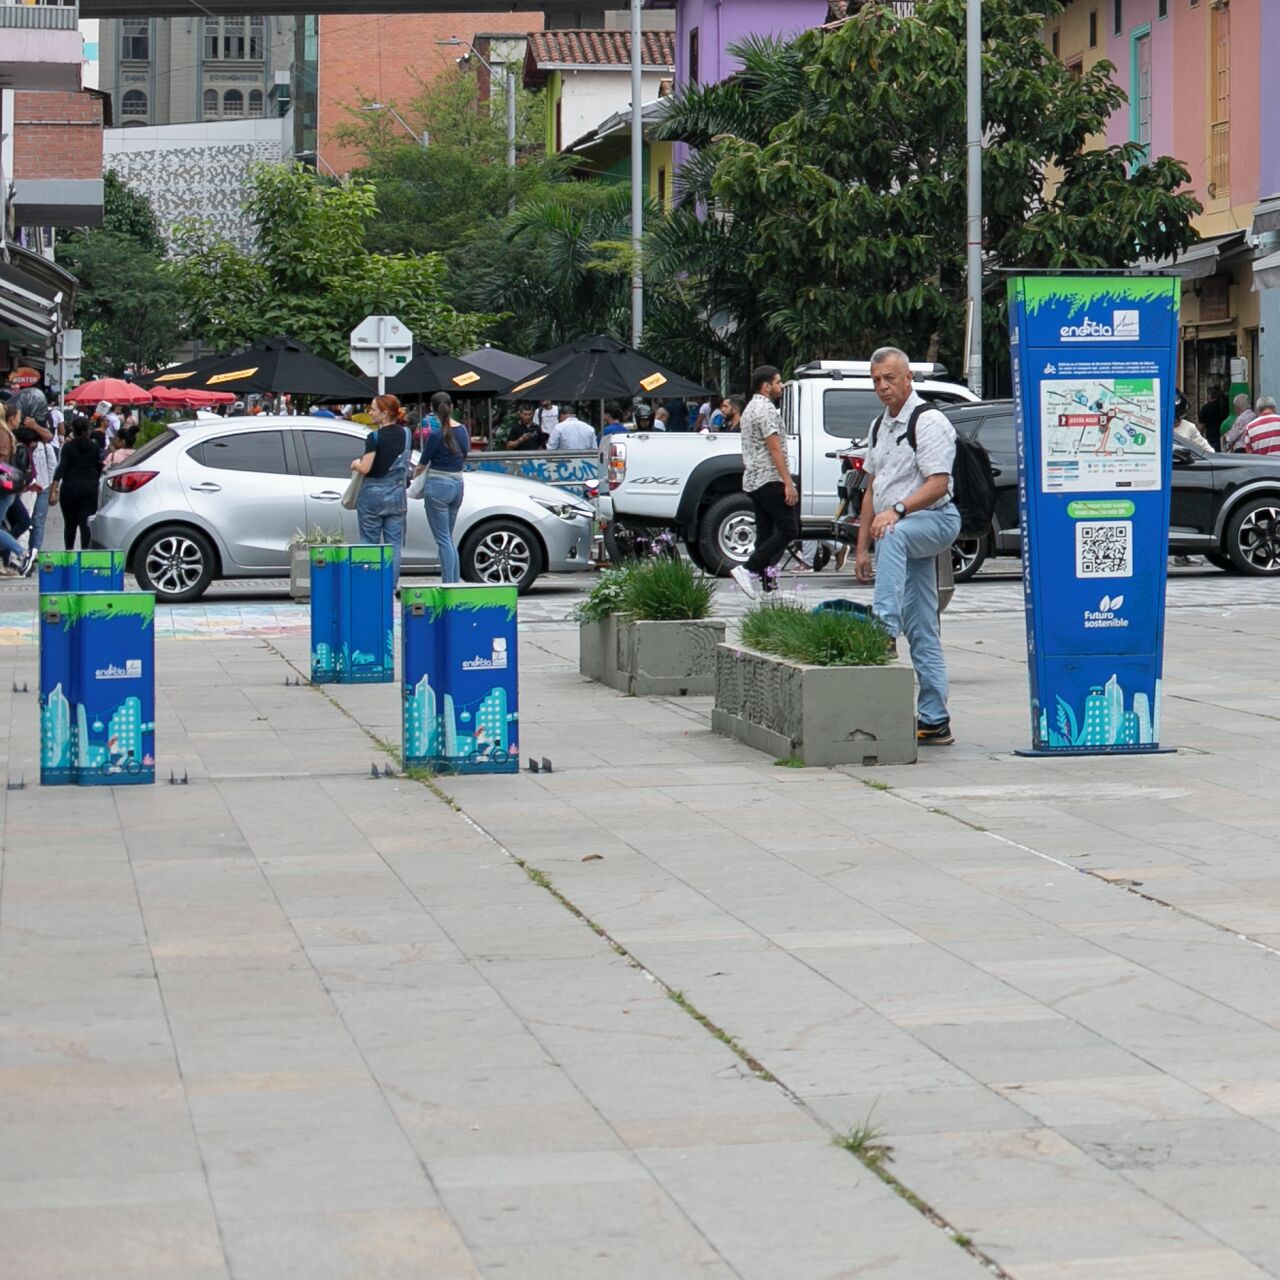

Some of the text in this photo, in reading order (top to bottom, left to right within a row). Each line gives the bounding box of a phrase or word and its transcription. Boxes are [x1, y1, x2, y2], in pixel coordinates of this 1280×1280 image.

[1013, 357, 1032, 594] PARQUE DE LAS LUCES
[1084, 610, 1114, 621] Futuro
[1084, 617, 1129, 629] sostenible
